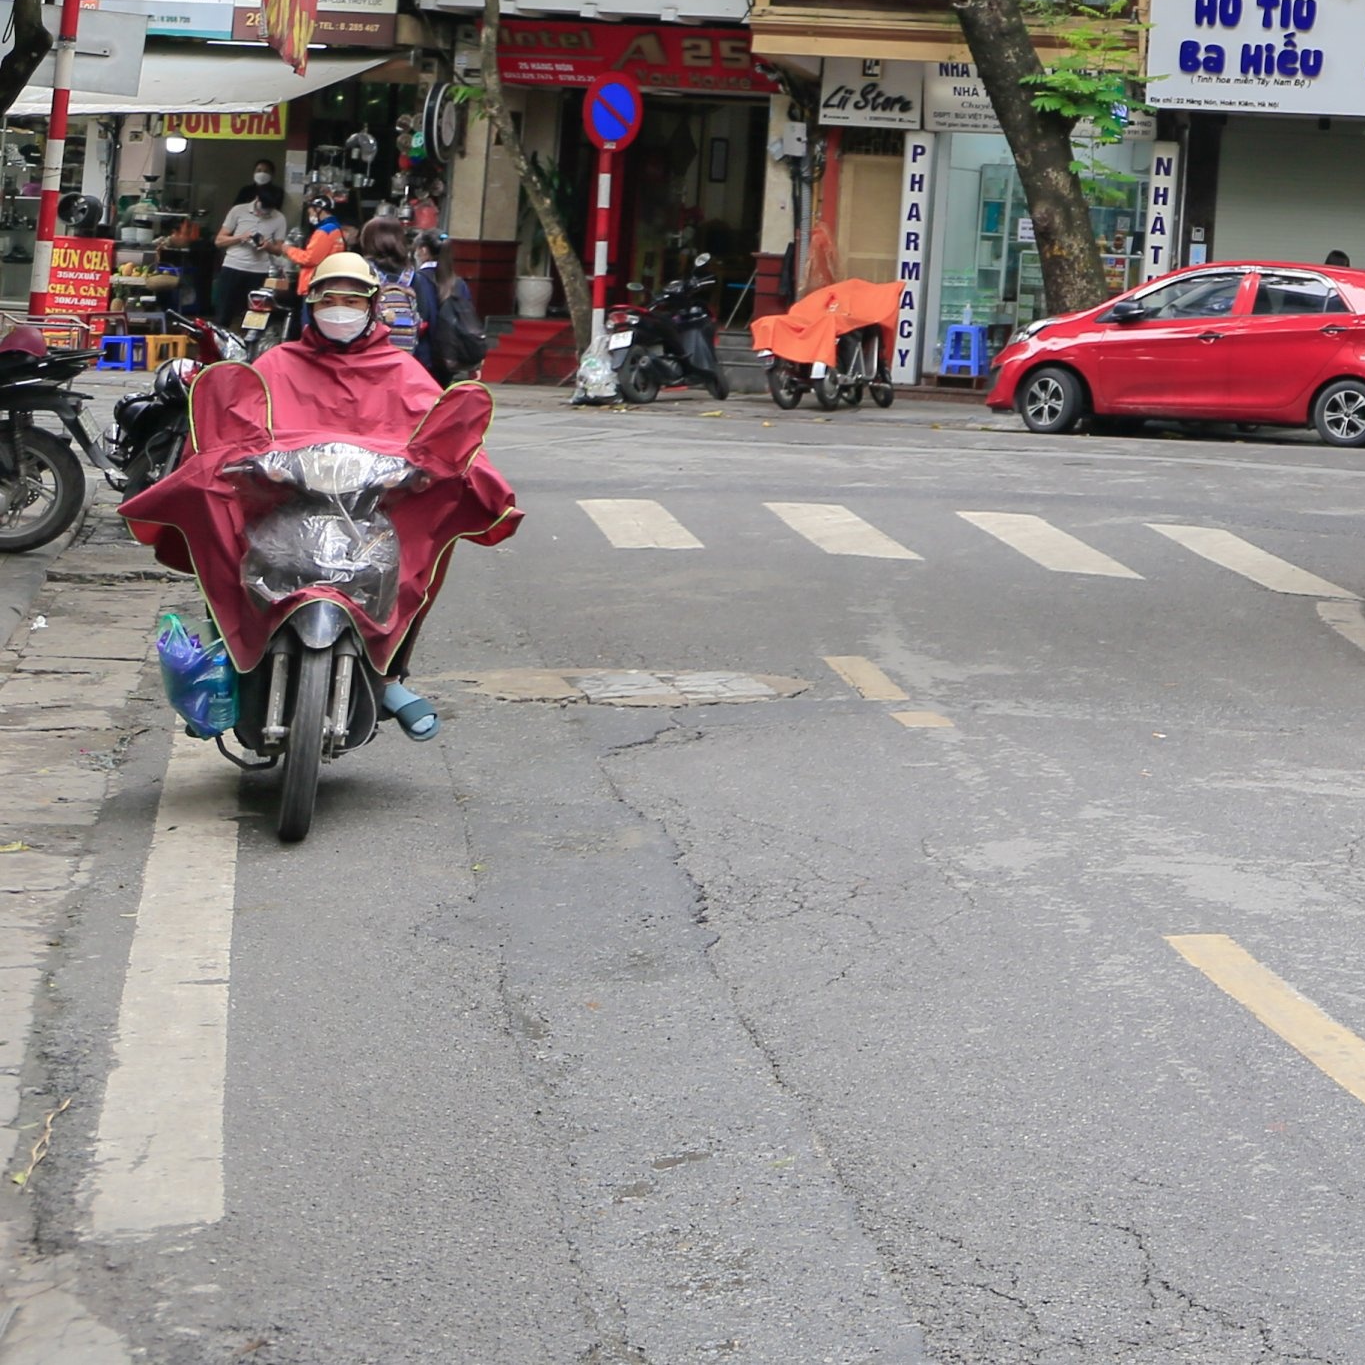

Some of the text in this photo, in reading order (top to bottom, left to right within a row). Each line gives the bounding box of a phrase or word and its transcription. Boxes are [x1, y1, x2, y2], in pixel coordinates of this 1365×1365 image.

[610, 31, 751, 70] A 25
[853, 82, 914, 114] Store
[51, 242, 111, 271] BÚN CHẢ
[897, 143, 928, 370] PHARMACY
